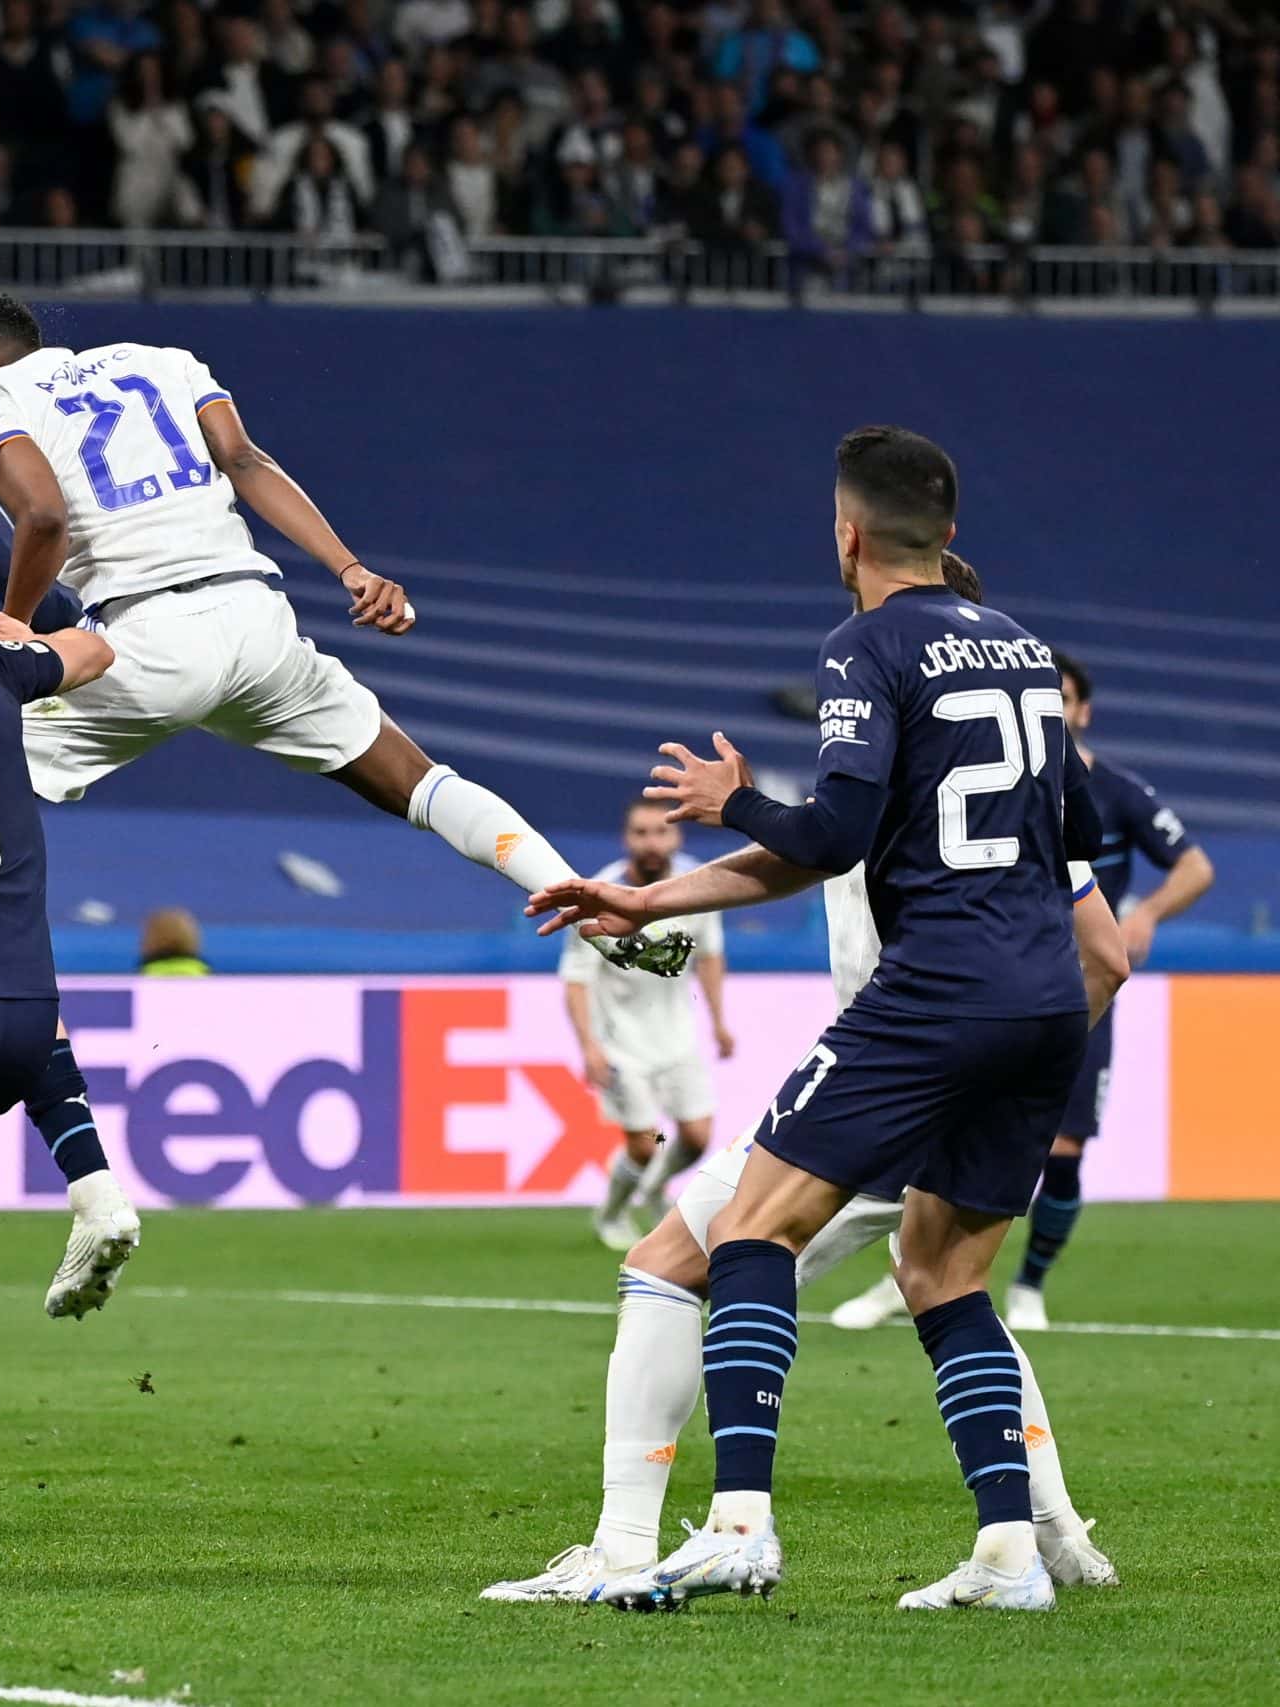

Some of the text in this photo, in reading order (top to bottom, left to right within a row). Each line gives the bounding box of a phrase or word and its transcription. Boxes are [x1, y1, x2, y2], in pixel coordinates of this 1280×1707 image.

[55, 373, 212, 513] 21
[920, 633, 986, 679] JOÃO
[756, 1390, 781, 1409] CIT
[1003, 1428, 1023, 1443] CIT
